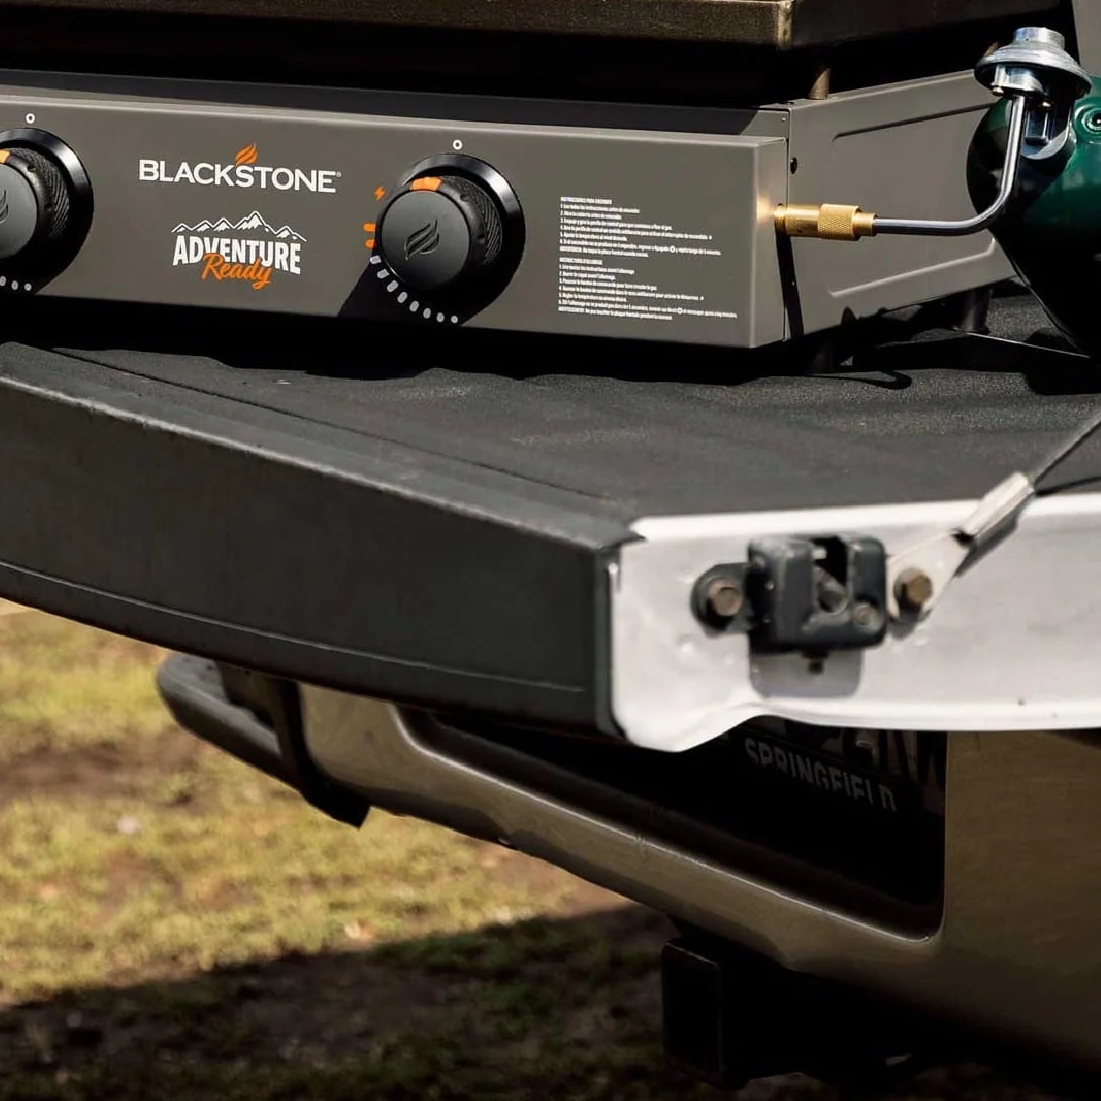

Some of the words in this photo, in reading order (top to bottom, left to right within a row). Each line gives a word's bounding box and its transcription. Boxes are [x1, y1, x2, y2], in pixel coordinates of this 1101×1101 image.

[139, 159, 337, 194] BLACKSTONE
[172, 235, 301, 275] ADVENTURE
[201, 252, 274, 290] Ready
